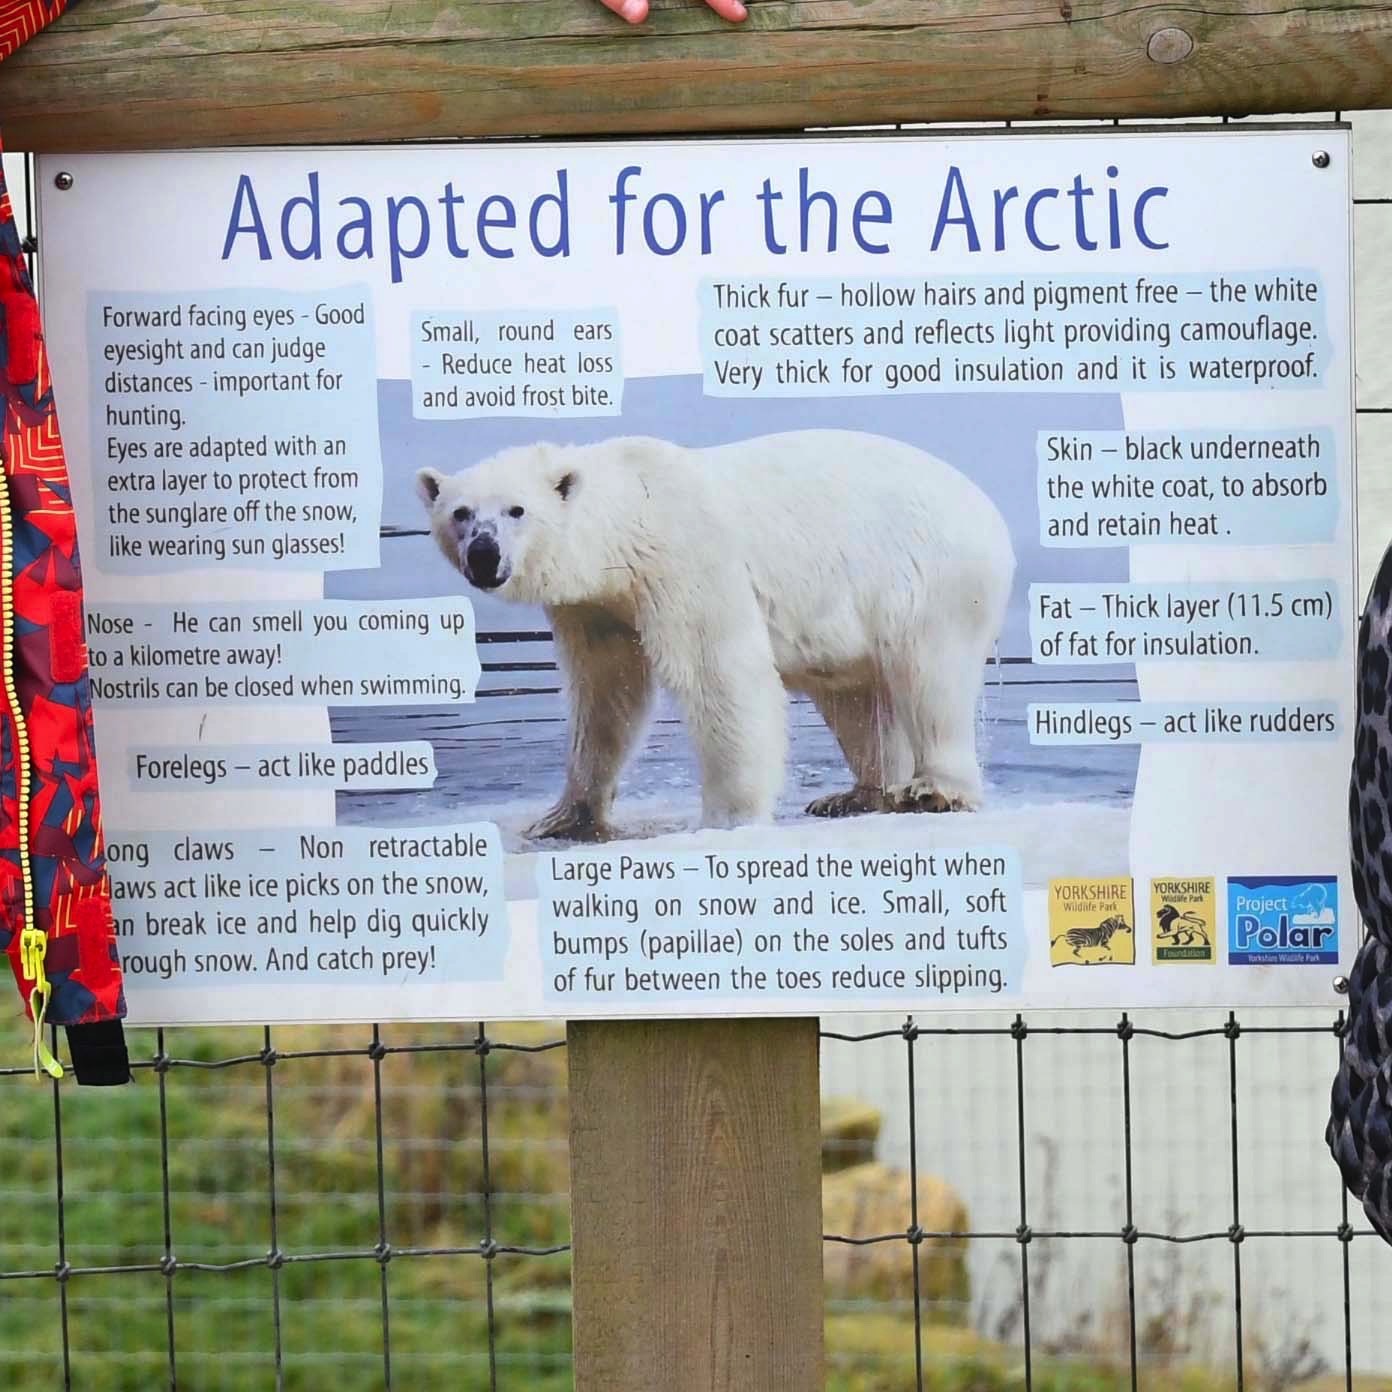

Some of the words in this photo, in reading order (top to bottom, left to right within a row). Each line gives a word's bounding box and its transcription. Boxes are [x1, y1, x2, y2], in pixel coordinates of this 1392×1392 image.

[221, 168, 571, 284] Adapted
[608, 165, 724, 256] for
[756, 166, 894, 256] the
[930, 164, 1171, 254] Arctic
[713, 283, 771, 309] Thick
[777, 282, 809, 308] fur
[841, 282, 916, 307] hollow
[924, 281, 976, 306] hairs
[984, 280, 1024, 306] and
[1034, 282, 1128, 311] pigment
[1135, 278, 1178, 303] free
[1209, 277, 1247, 303] the
[1254, 277, 1317, 302] white
[103, 304, 182, 327] Forward
[188, 304, 246, 331] facing
[253, 309, 294, 331] eyes
[315, 302, 364, 325] Good
[421, 320, 479, 344] Small,
[499, 319, 554, 341] round
[574, 324, 612, 341] ears
[714, 325, 760, 347] coat
[770, 324, 854, 346] scatters
[863, 319, 903, 345] and
[915, 318, 995, 344] reflects
[1005, 318, 1055, 350] light
[1064, 316, 1170, 349] providing
[1180, 314, 1317, 346] camouflage.
[104, 338, 184, 366] eyesight
[190, 337, 225, 359] and
[232, 342, 264, 359] can
[270, 336, 326, 364] judge
[442, 353, 512, 375] Reduce
[524, 352, 566, 374] heat
[578, 352, 613, 373] loss
[105, 371, 193, 393] distances
[213, 371, 311, 397] important
[316, 368, 343, 390] for
[714, 360, 763, 391] Very
[776, 358, 830, 384] thick
[841, 357, 873, 383] for
[885, 357, 941, 389] good
[955, 356, 1063, 382] insulation
[1077, 355, 1118, 380] and
[1132, 358, 1147, 380] it
[1160, 361, 1176, 379] is
[1189, 352, 1317, 385] waterproof.
[108, 437, 147, 464] Eyes
[154, 441, 183, 458] are
[189, 435, 267, 463] adapted
[274, 434, 316, 456] with
[324, 440, 346, 456] an
[1047, 436, 1092, 461] Skin
[1125, 435, 1183, 461] black
[1190, 433, 1320, 460] underneath
[108, 472, 155, 491] extra
[162, 469, 207, 496] layer
[213, 471, 232, 490] to
[239, 470, 308, 495] protect
[313, 466, 358, 488] from
[1047, 474, 1084, 499] the
[1091, 474, 1154, 499] white
[1162, 476, 1214, 501] coat,
[1221, 475, 1244, 497] to
[1252, 471, 1327, 497] absorb
[108, 502, 140, 524] the
[146, 501, 227, 528] sunglare
[233, 499, 261, 522] off
[265, 500, 296, 522] the
[302, 505, 357, 523] snow,
[1048, 512, 1088, 537] and
[1098, 514, 1160, 536] retain
[1170, 511, 1219, 536] heat
[1040, 595, 1072, 619] Fat
[1103, 593, 1160, 618] Thick
[1167, 593, 1220, 624] layer
[1228, 592, 1283, 621] (11.5
[1291, 591, 1332, 620] cm)
[87, 613, 133, 634] Nose
[174, 611, 198, 633] He
[209, 616, 241, 632] can
[252, 610, 302, 632] smell
[313, 615, 347, 636] you
[359, 610, 429, 635] coming
[440, 614, 464, 635] up
[87, 648, 107, 667] to
[113, 651, 123, 666] a
[130, 644, 220, 666] kilometre
[227, 643, 281, 669] away!
[89, 675, 161, 700] Nostrils
[166, 682, 198, 698] can
[205, 676, 228, 698] be
[235, 674, 293, 697] closed
[301, 674, 353, 696] when
[360, 674, 466, 700] swimming.
[1036, 709, 1132, 740] Hindlegs
[1164, 712, 1197, 733] act
[1205, 708, 1242, 733] like
[1250, 707, 1335, 732] rudders
[137, 753, 227, 784] Forelegs
[258, 755, 291, 777] act
[299, 752, 335, 777] like
[343, 750, 428, 783] paddles
[104, 839, 149, 867] ong
[174, 836, 234, 861] claws
[300, 834, 343, 859] Non
[370, 832, 487, 858] retractable
[552, 857, 612, 887] Large
[620, 856, 675, 880] Paws
[704, 854, 729, 879] To
[736, 853, 808, 885] spread
[816, 853, 853, 878] the
[860, 852, 937, 883] weight
[944, 852, 1005, 876] when
[1054, 884, 1128, 900] YORKSHIRE
[1153, 881, 1211, 895] YORKSHIRE
[1160, 894, 1187, 904] Wildlife
[1189, 894, 1205, 903] Park
[552, 893, 638, 923] walking
[655, 899, 681, 917] on
[698, 898, 757, 916] snow
[773, 890, 813, 915] and
[831, 896, 866, 914] ice.
[883, 889, 949, 917] Small,
[966, 888, 1007, 913] soft
[1063, 902, 1097, 912] Wildlife
[1099, 901, 1118, 912] Park
[1236, 895, 1288, 915] Project
[553, 931, 628, 960] bumps
[640, 928, 742, 960] (papillae)
[755, 934, 781, 952] on
[793, 928, 829, 952] the
[840, 927, 894, 952] soles
[905, 926, 945, 951] and
[957, 925, 1007, 950] tufts
[1236, 915, 1334, 950] Polar
[554, 967, 577, 992] of
[584, 966, 615, 991] fur
[625, 967, 720, 991] between
[731, 965, 767, 990] the
[776, 968, 822, 989] toes
[832, 964, 905, 989] reduce
[915, 963, 1007, 994] slipping.
